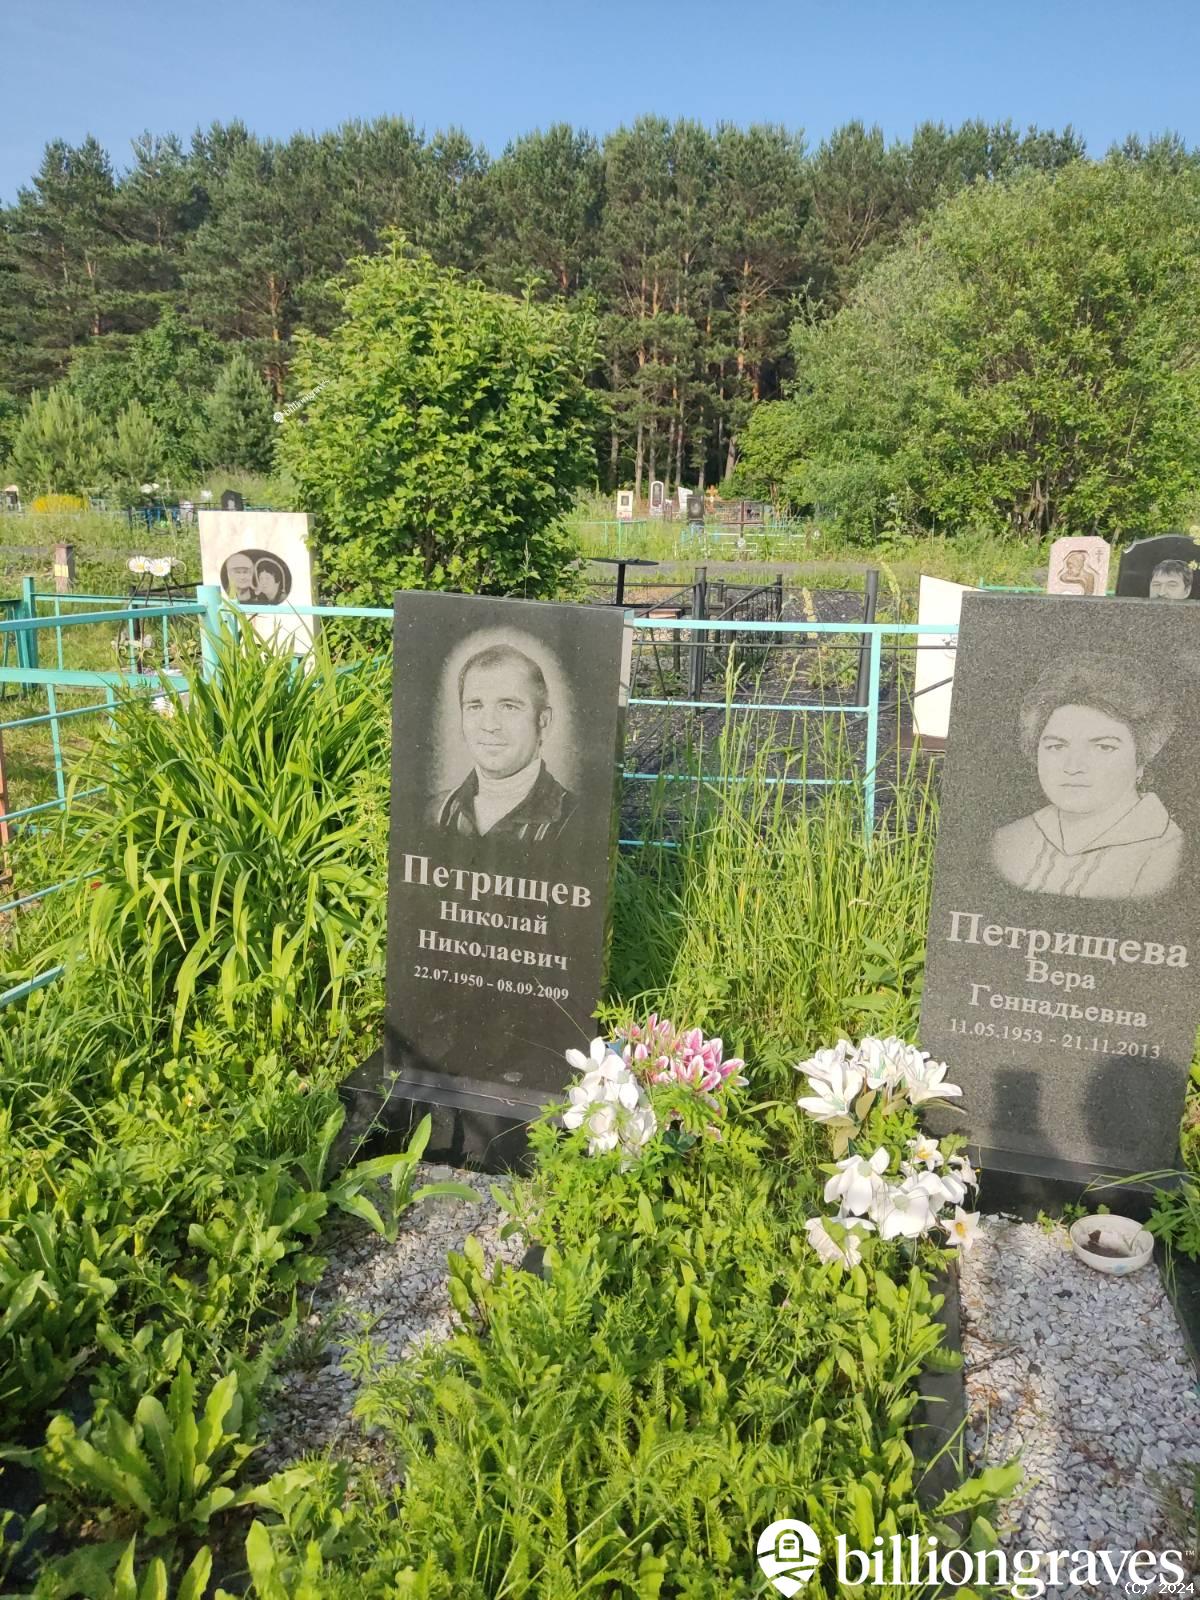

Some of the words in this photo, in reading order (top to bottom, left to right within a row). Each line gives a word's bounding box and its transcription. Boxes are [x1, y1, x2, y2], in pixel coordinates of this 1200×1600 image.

[402, 853, 592, 908] Петрищев
[440, 900, 548, 935] Николай
[417, 928, 569, 971] Николаевич
[946, 911, 1190, 968] Петрищева
[413, 965, 484, 988] 22.07.1950
[497, 979, 570, 1001] 08.09.2009
[1025, 959, 1096, 993] Вера
[968, 983, 1149, 1028] Геннадьевна
[949, 1018, 1043, 1044] 11.05.1953
[1062, 1034, 1162, 1059] 21.11.2013
